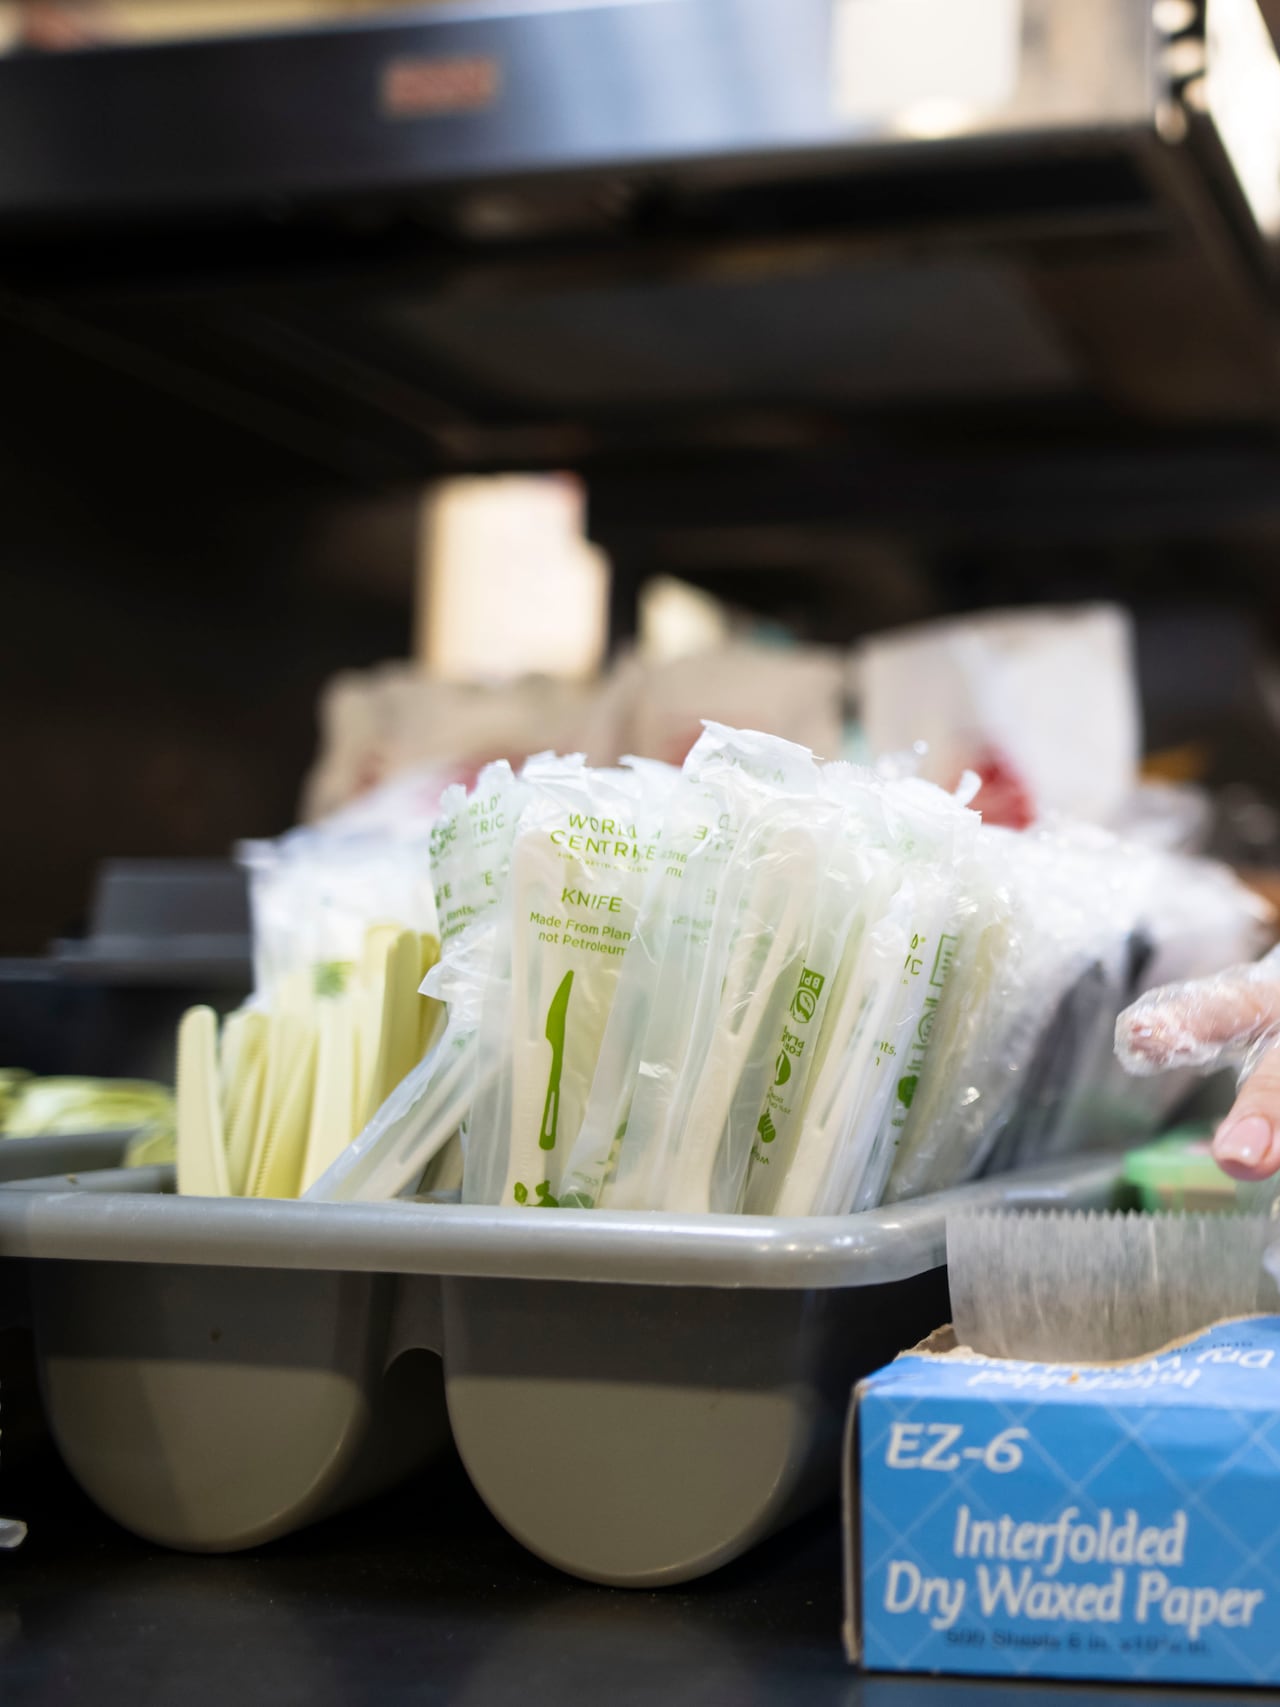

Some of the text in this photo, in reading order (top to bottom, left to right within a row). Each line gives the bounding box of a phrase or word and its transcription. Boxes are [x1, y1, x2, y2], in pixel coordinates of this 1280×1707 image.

[561, 886, 624, 913] KNIFE
[529, 911, 632, 941] Made From Plan
[538, 931, 559, 944] not
[885, 1421, 1030, 1473] EZ-6
[953, 1503, 1188, 1576] Interfolded
[884, 1559, 1265, 1640] Dry Waxed Paper
